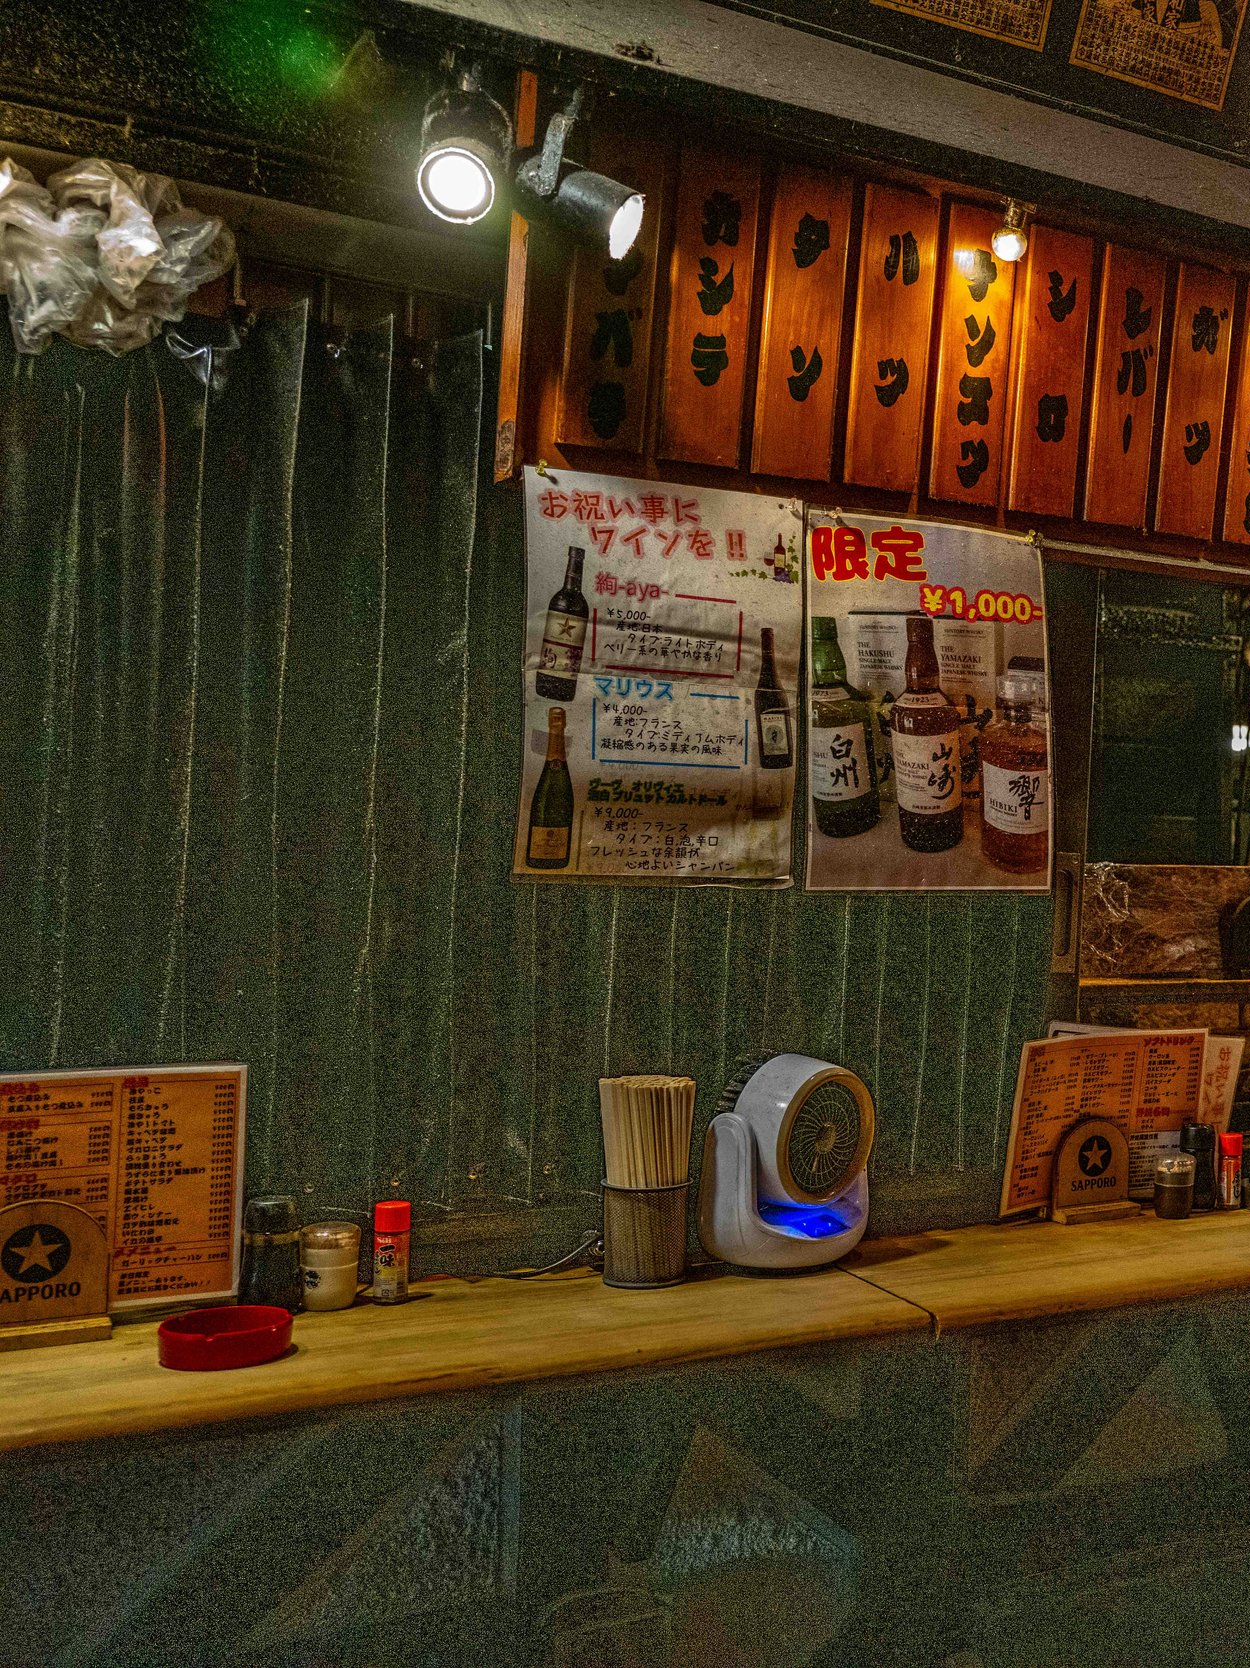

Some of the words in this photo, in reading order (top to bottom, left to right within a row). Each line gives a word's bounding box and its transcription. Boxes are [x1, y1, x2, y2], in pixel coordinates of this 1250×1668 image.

[787, 211, 831, 402] タン
[875, 230, 920, 408] ハツ
[956, 247, 998, 489] ナンコツ
[1036, 269, 1077, 444] シロ
[1117, 286, 1154, 455] レバー
[540, 490, 700, 525] お祝い事に
[810, 526, 928, 583] 限定
[920, 584, 1043, 624] ¥1,000-
[857, 641, 871, 649] THE
[858, 650, 895, 658] HAKUSHU
[940, 646, 954, 654] THE
[940, 654, 982, 664] YAMAZAKI
[593, 676, 674, 701] マリウス
[829, 733, 859, 789] 白州
[989, 797, 1018, 813] HIBIKI
[1008, 774, 1044, 821] 響
[1071, 1176, 1117, 1192] SAPPORO
[0, 1282, 81, 1303] APPORO
